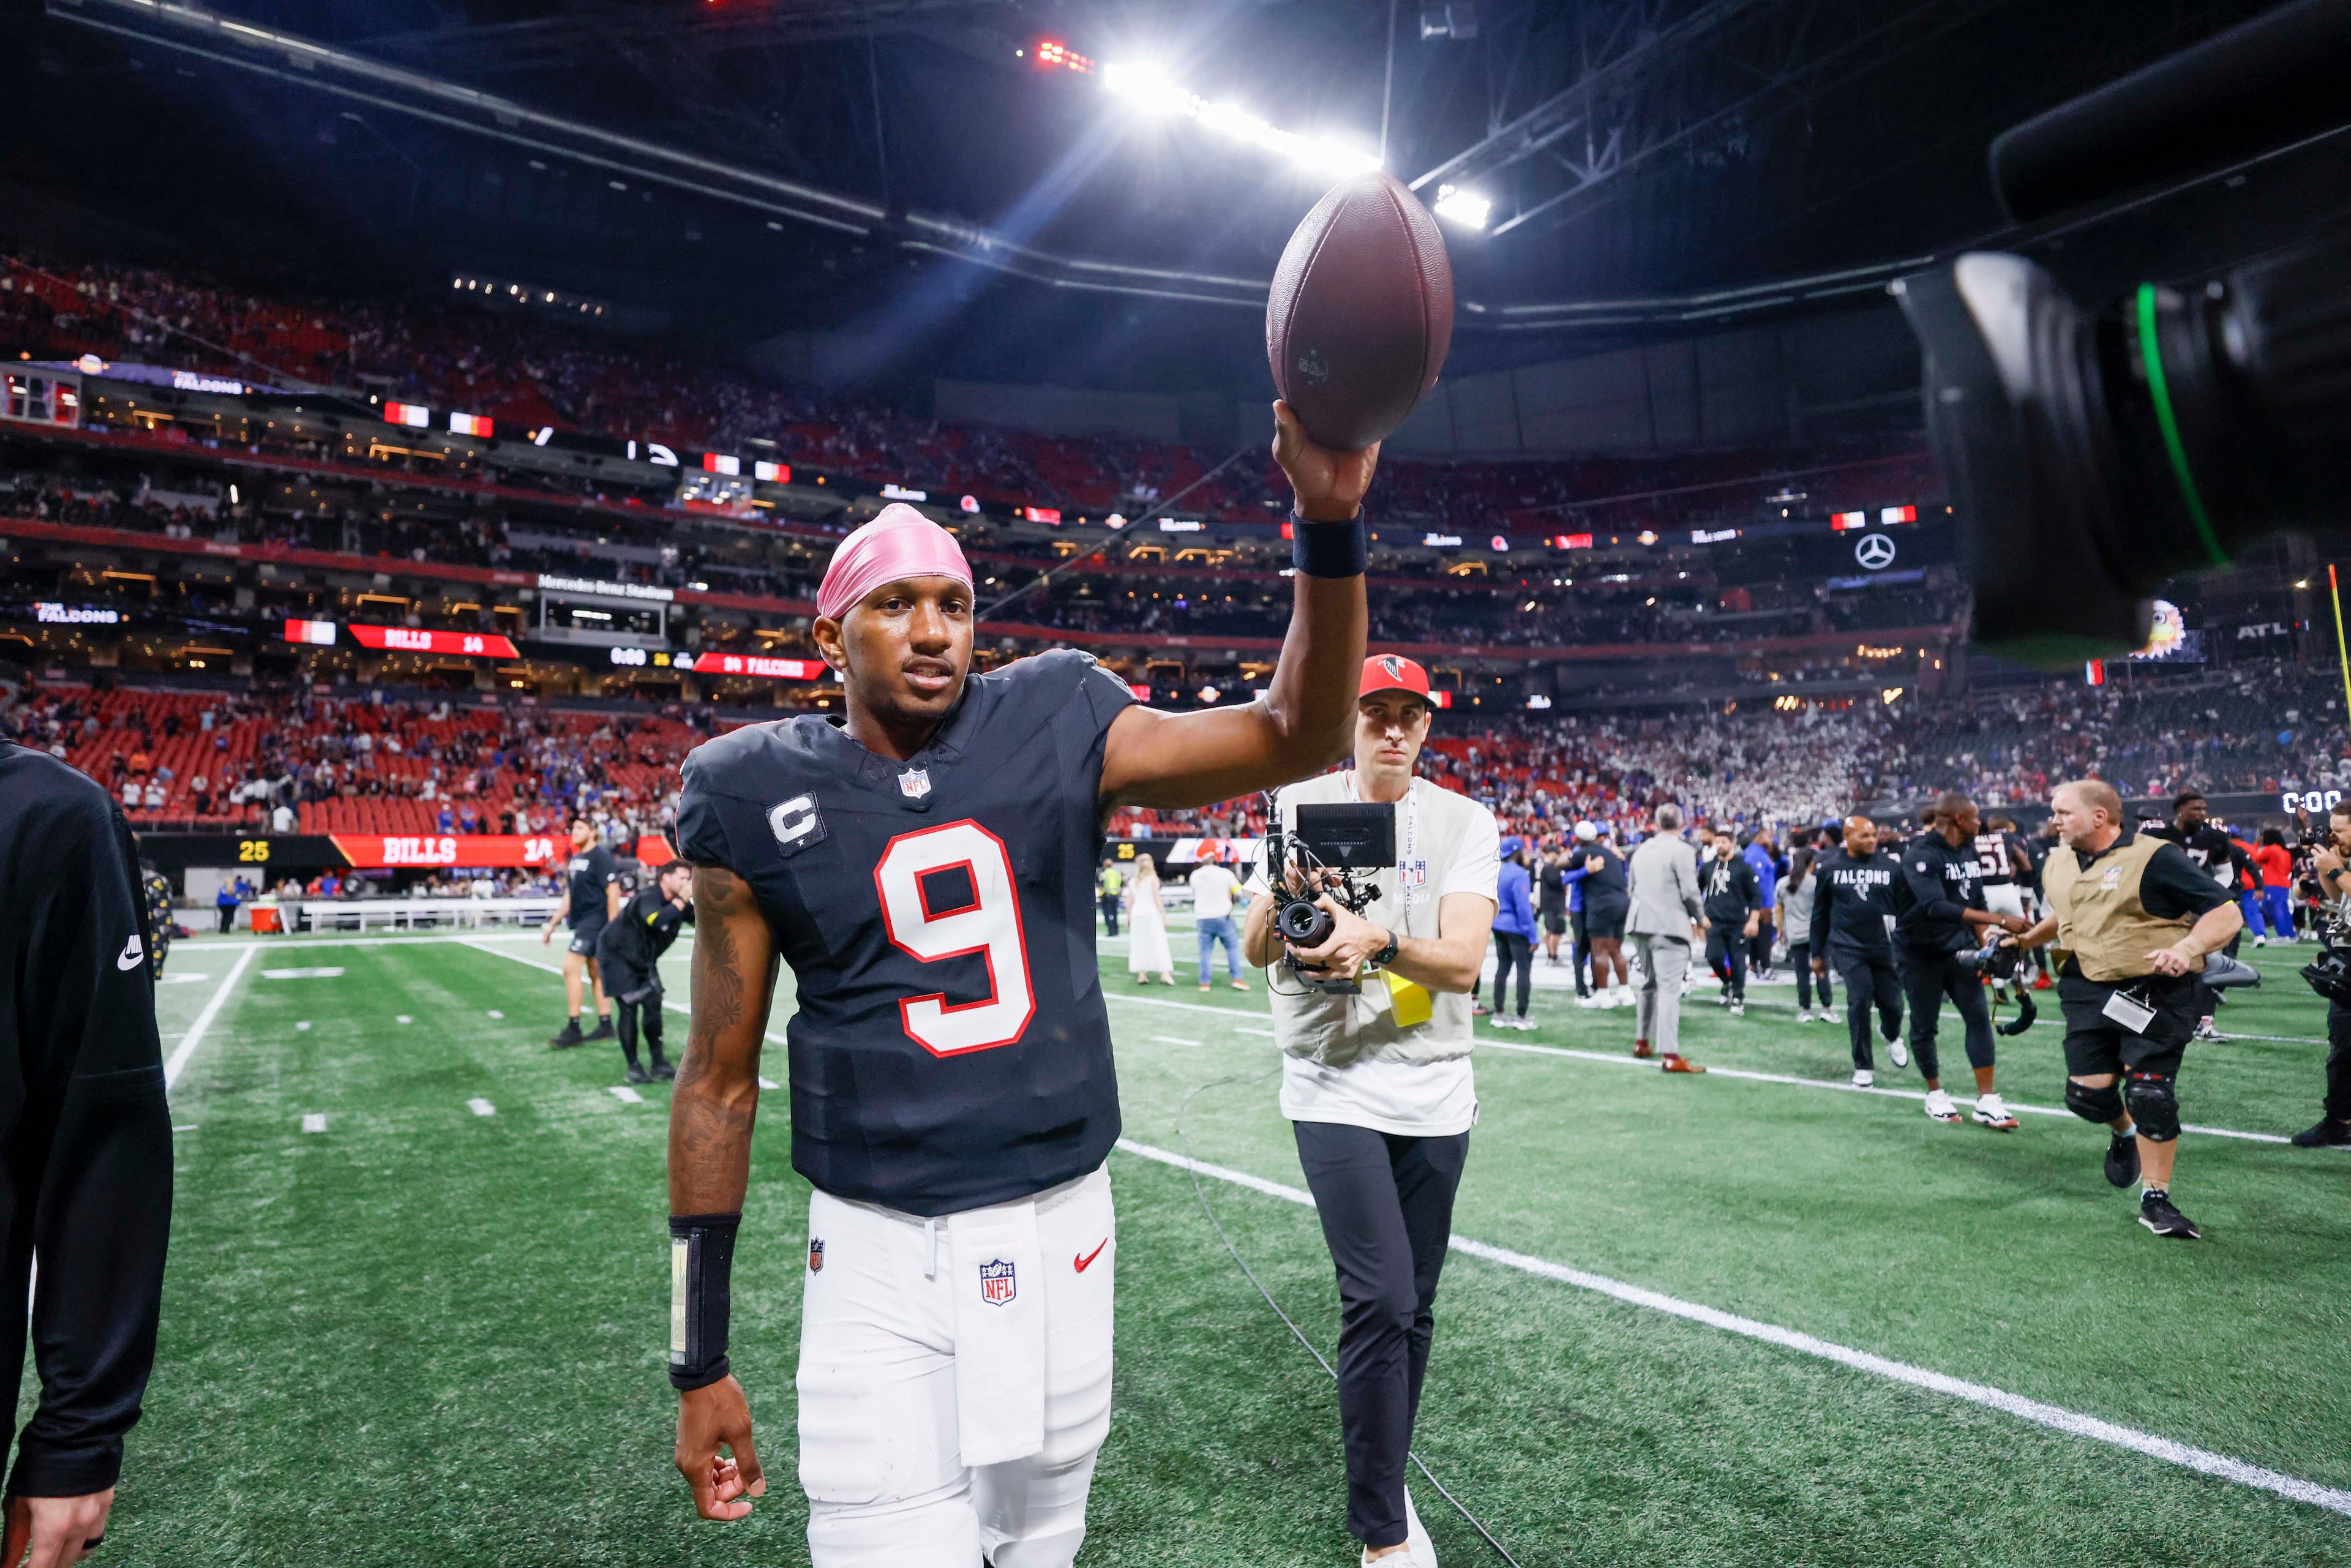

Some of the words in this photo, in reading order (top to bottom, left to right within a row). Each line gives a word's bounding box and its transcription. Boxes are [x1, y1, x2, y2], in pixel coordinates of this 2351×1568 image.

[384, 629, 432, 650] BILLS
[2238, 622, 2289, 639] ATL
[747, 658, 804, 677] FALCONS
[905, 781, 926, 792] NFL
[770, 797, 816, 842] C
[239, 841, 269, 861] 25
[383, 837, 457, 863] BILLS
[1975, 843, 2011, 877] 51
[1833, 869, 1890, 885] FALCONS
[1393, 893, 1431, 904] MDIA
[874, 817, 1036, 1059] 9
[984, 1278, 1013, 1300] NFL
